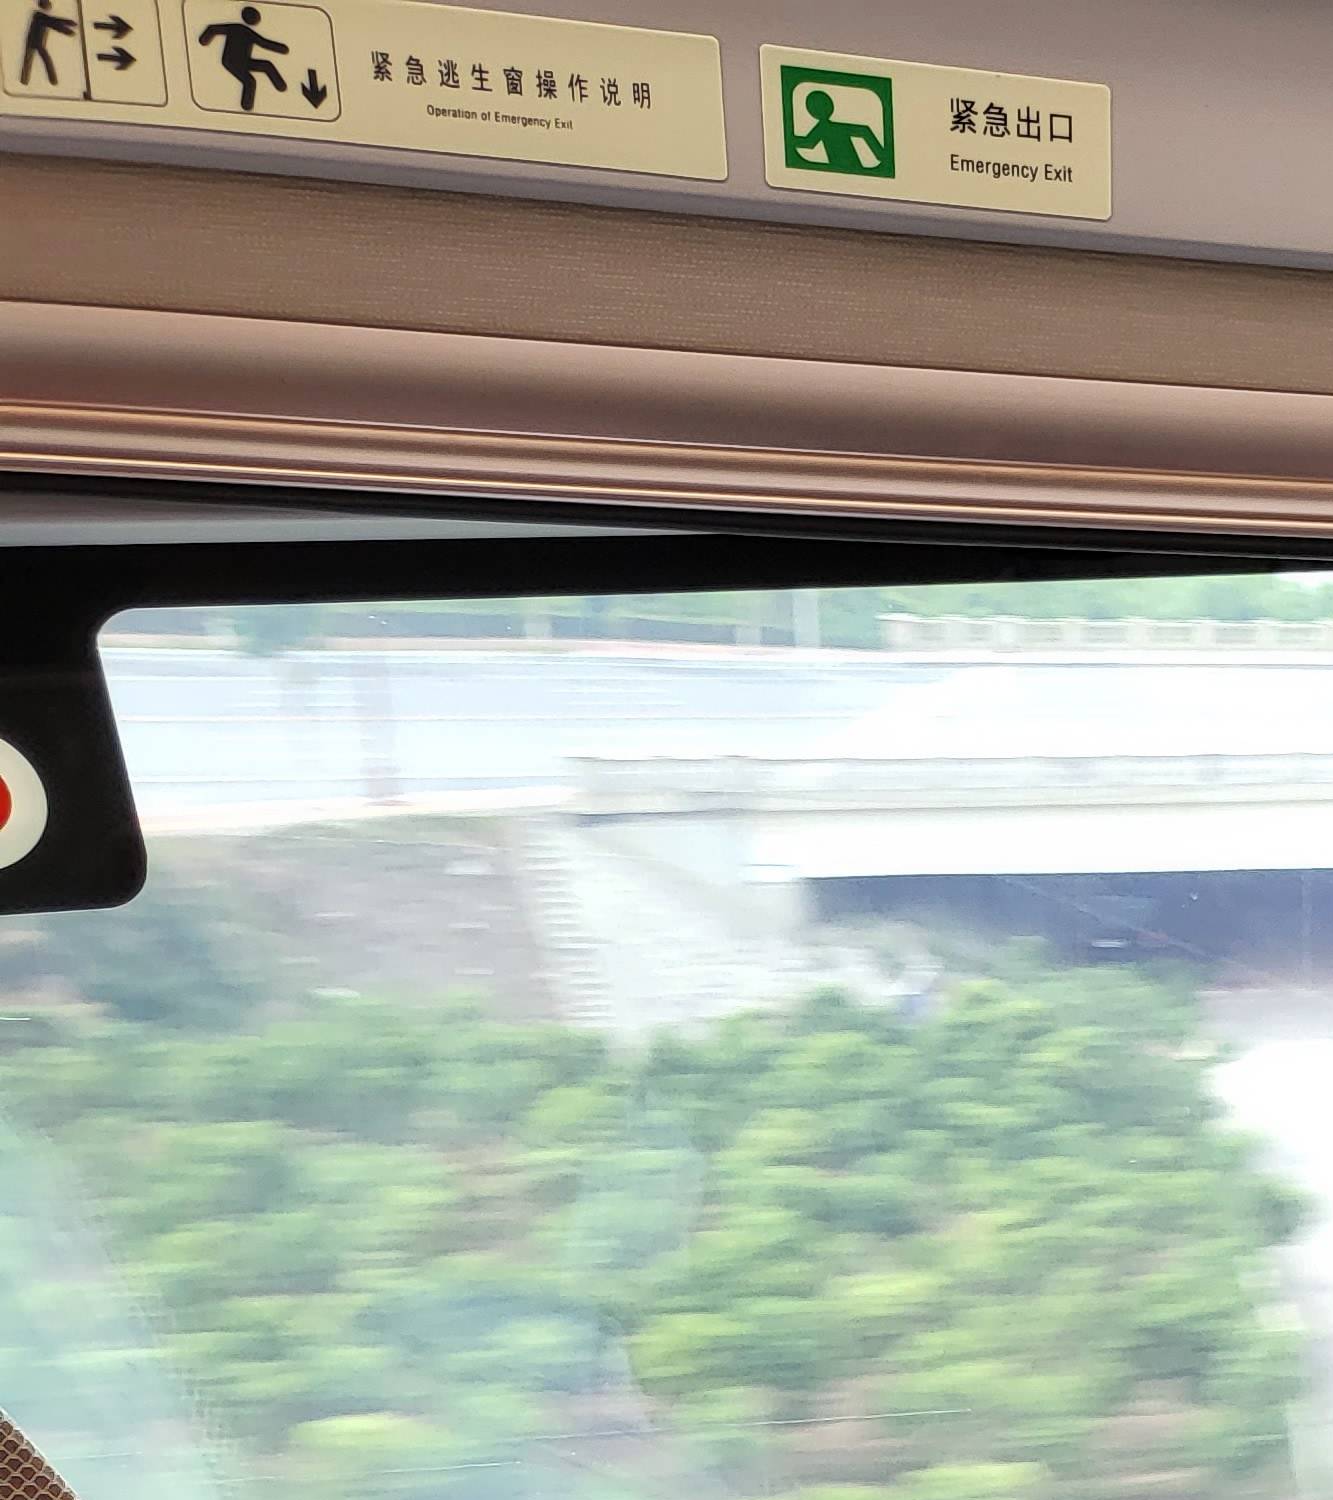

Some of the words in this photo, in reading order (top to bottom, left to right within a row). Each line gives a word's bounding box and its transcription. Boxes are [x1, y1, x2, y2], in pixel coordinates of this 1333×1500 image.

[370, 50, 652, 110] 紧急逃生窗操作说明
[426, 104, 478, 121] Operation
[480, 111, 491, 122] of
[494, 111, 551, 130] Emergency
[554, 117, 574, 131] Exit
[949, 97, 1074, 143] 紧急出口
[949, 154, 1038, 183] Emergency
[1043, 163, 1073, 183] Exit
